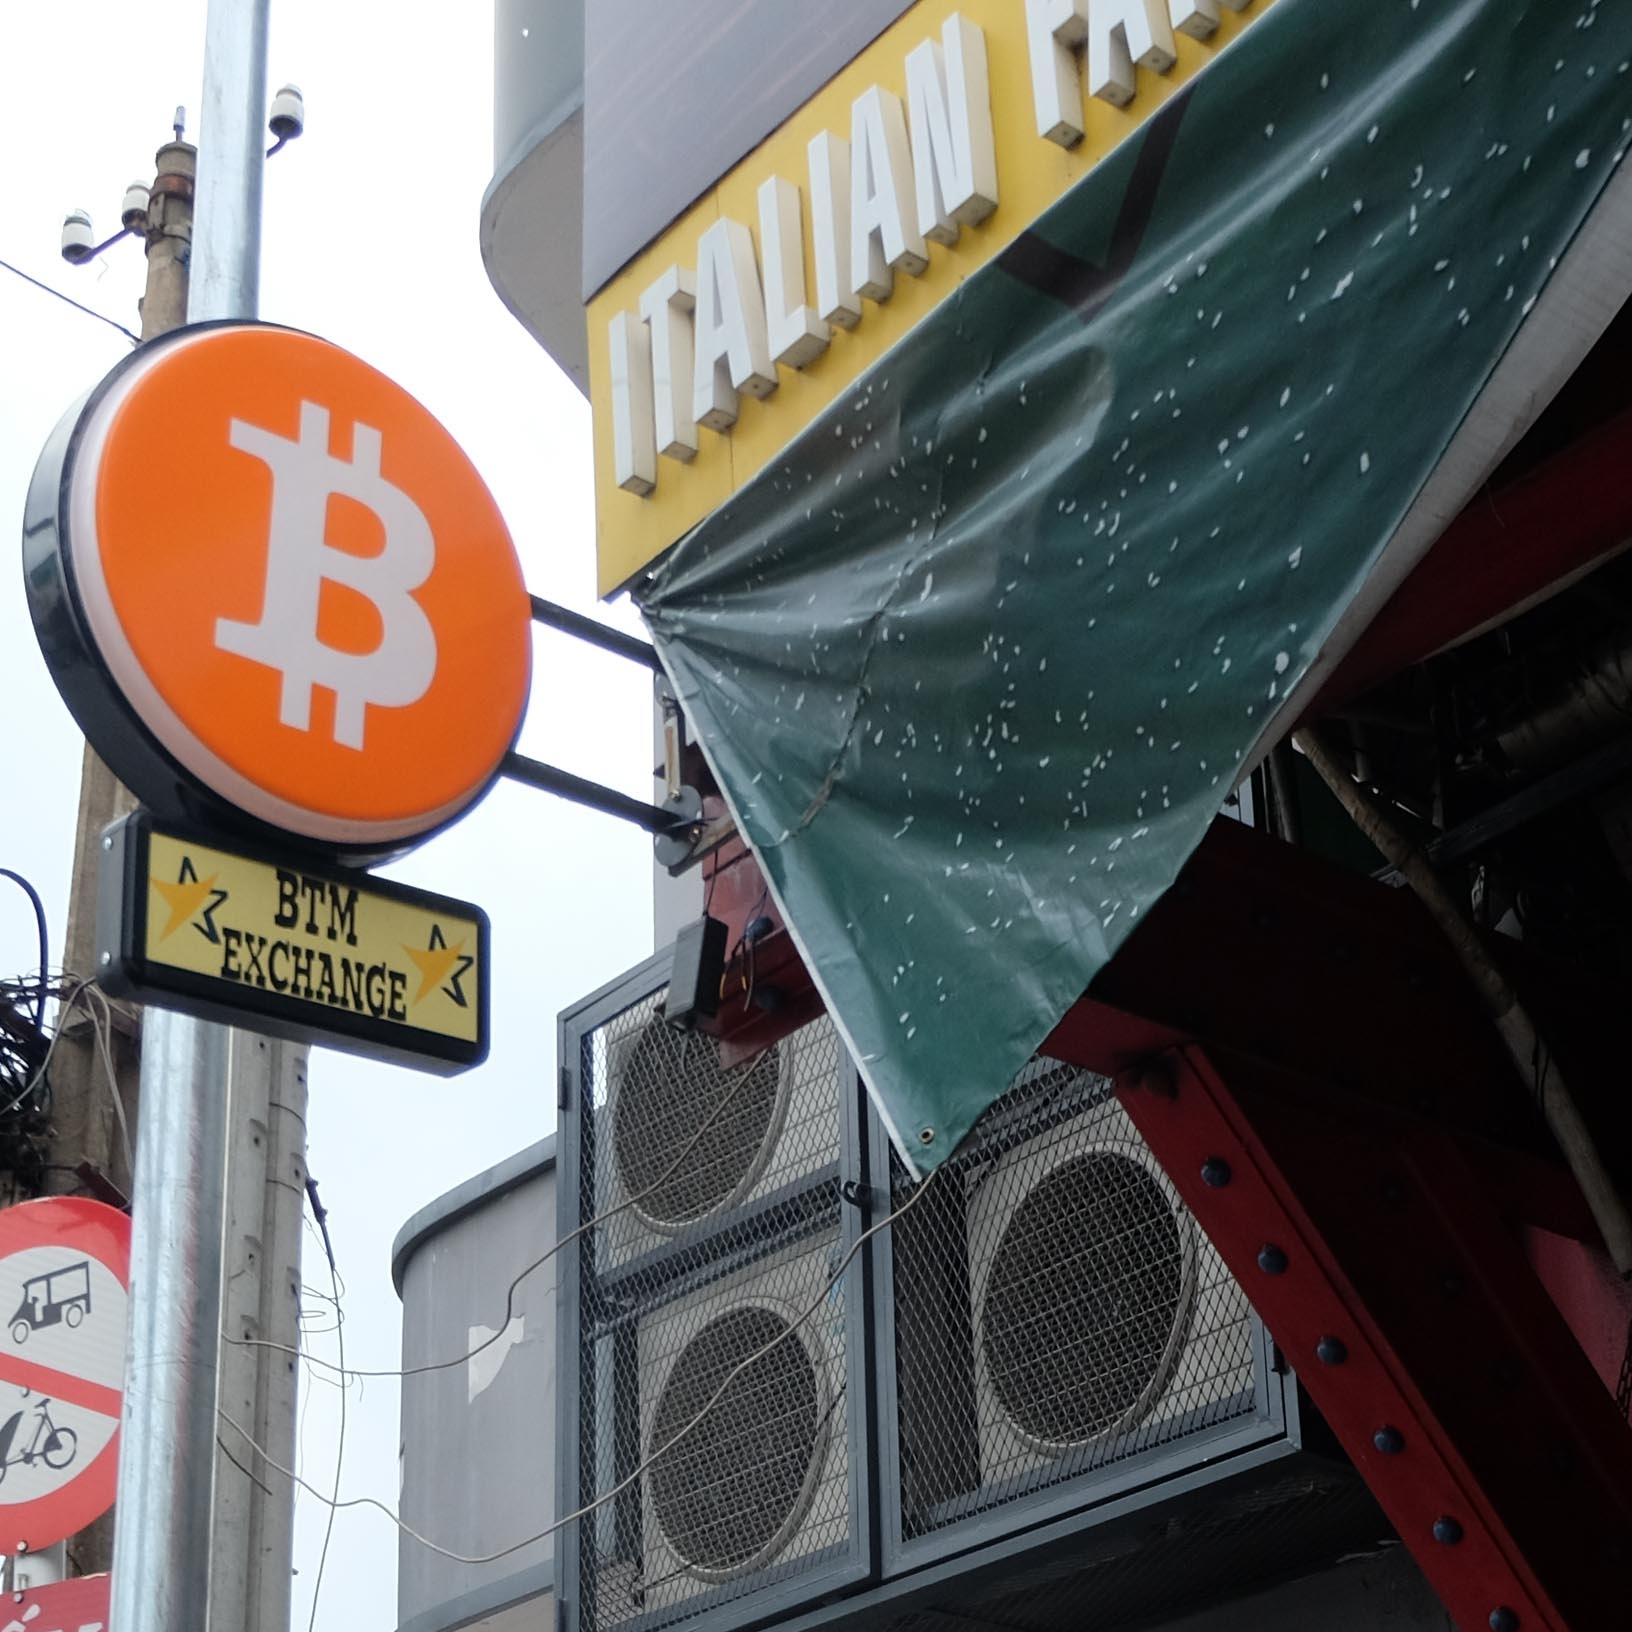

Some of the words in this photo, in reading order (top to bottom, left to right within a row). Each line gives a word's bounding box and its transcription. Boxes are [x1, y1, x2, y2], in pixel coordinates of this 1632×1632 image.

[608, 11, 998, 497] ITALIAN
[273, 868, 358, 947] BTM
[221, 926, 408, 1022] EXCHANGE
